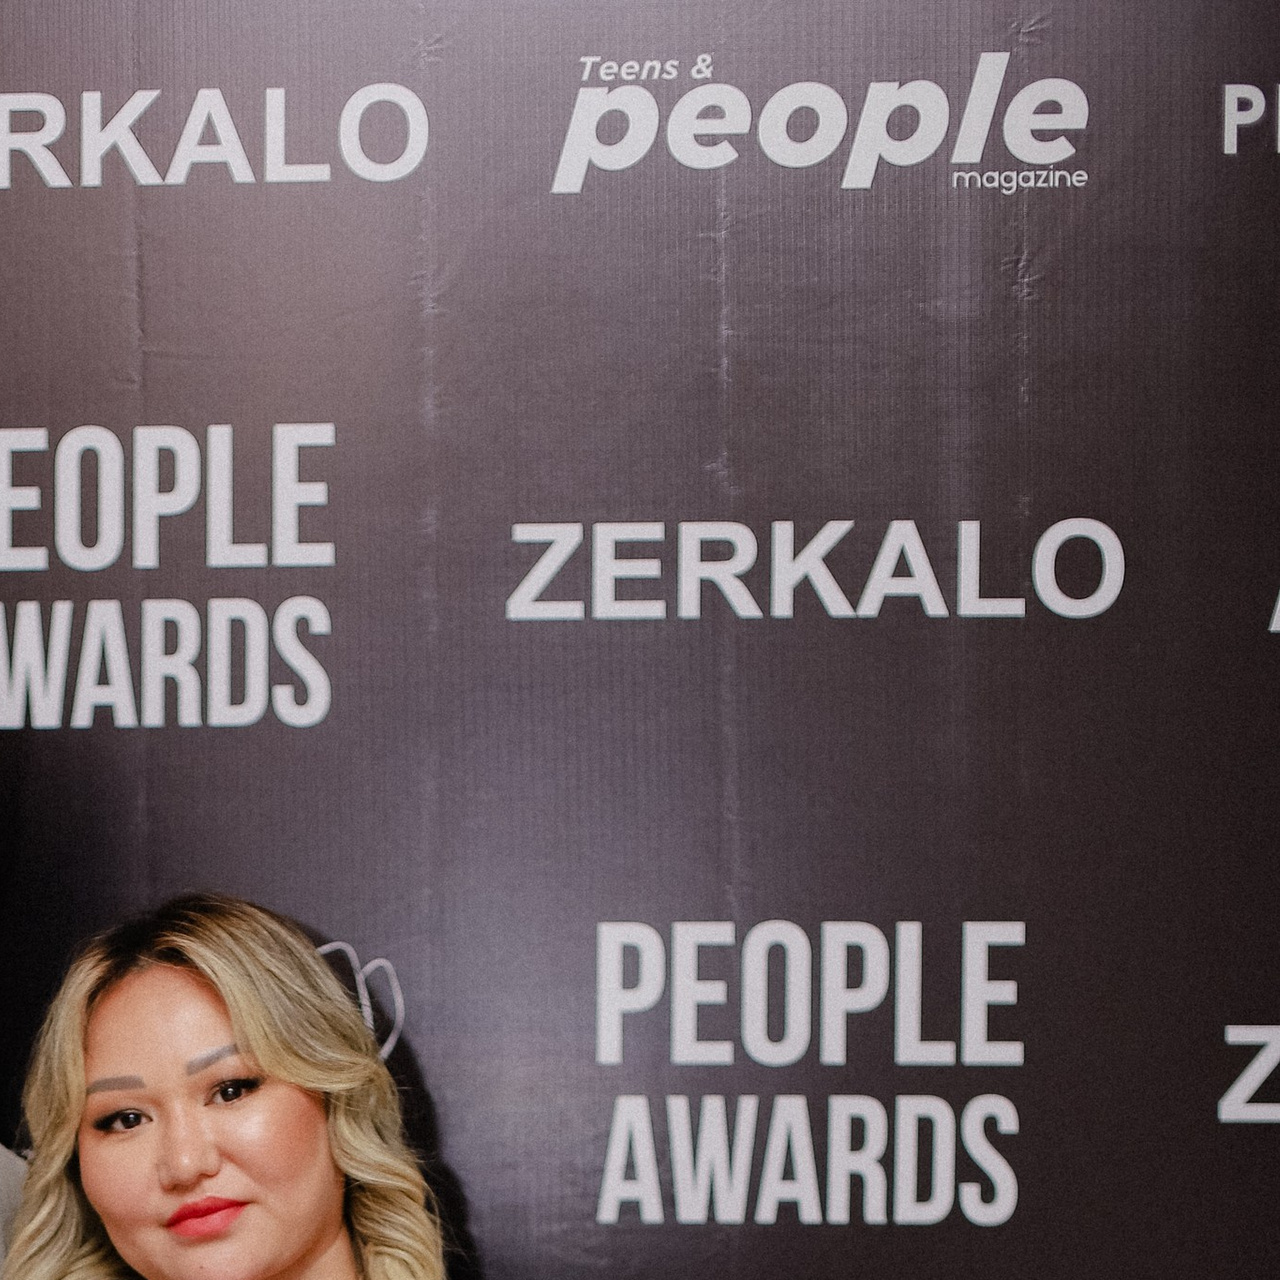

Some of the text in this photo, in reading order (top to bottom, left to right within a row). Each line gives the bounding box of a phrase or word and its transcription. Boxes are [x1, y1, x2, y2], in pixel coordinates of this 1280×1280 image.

[550, 51, 1090, 194] people
[579, 54, 714, 82] Teens &
[951, 164, 1089, 196] magazine
[505, 517, 1126, 621] ZERKALO
[594, 919, 1027, 1067] PEOPLE
[596, 1093, 1021, 1227] AWARDS
